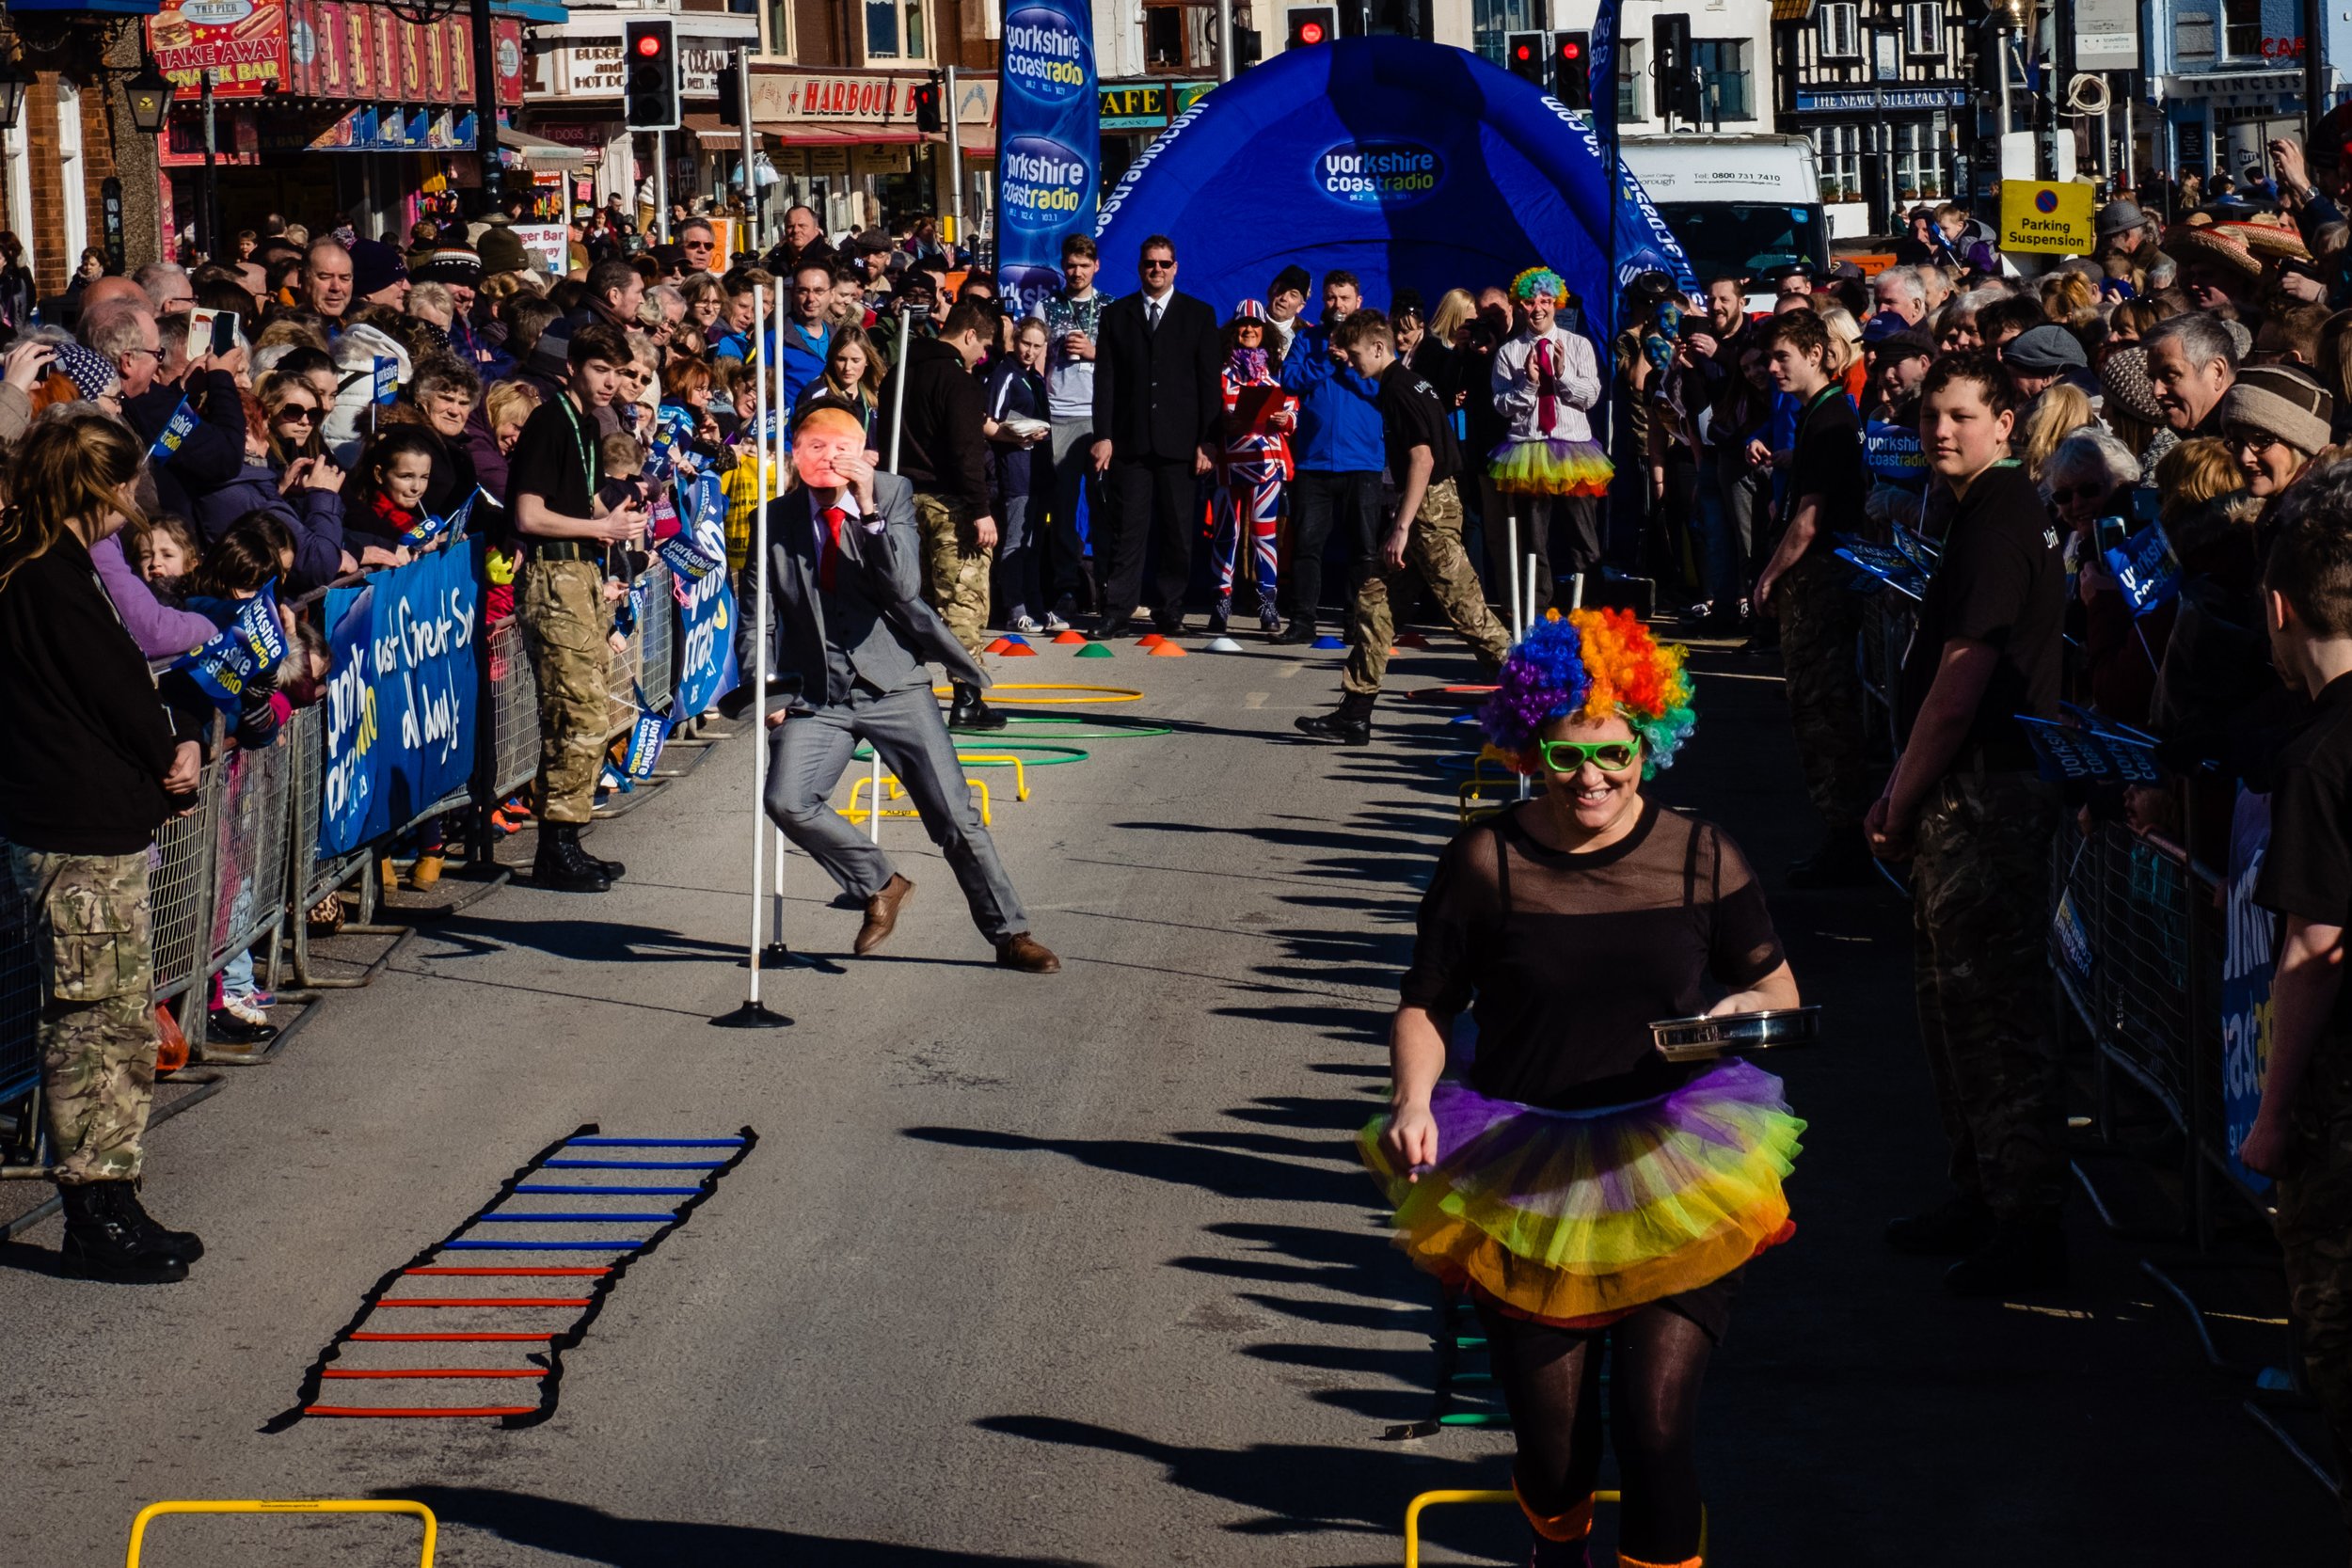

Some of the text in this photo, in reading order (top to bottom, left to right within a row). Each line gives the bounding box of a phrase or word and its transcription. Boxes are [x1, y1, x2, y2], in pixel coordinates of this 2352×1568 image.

[194, 3, 237, 14] THE PIER
[324, 12, 469, 93] LEISUR
[1006, 24, 1081, 59] yorkshire
[2261, 37, 2307, 58] CAF
[155, 43, 216, 70] TAKE
[221, 37, 282, 63] AWAY
[575, 48, 624, 60] BURGE
[166, 61, 279, 87] SNAK BAR
[594, 62, 624, 73] and
[1008, 53, 1084, 87] coastradio
[575, 75, 625, 88] HOT DO
[2191, 76, 2302, 93] PRINCESS
[803, 79, 898, 116] HARBOUR
[1099, 88, 1161, 114] AFE
[1813, 90, 1958, 107] THE NEWCSTLE PACKT
[555, 128, 584, 141] DOGS
[1006, 152, 1085, 186] yorkshire
[1326, 151, 1434, 176] yorkshire
[1327, 173, 1434, 192] coastradio
[1757, 173, 1781, 182] 7410
[1003, 180, 1079, 212] coastradio
[2021, 217, 2071, 233] Parking
[520, 230, 564, 245] ger Bar
[2009, 231, 2084, 247] Suspension
[1867, 436, 1921, 452] yorkshir
[669, 540, 716, 570] yorkshire
[327, 642, 367, 760] york
[628, 717, 650, 775] coastradio
[638, 719, 662, 777] yorkshire
